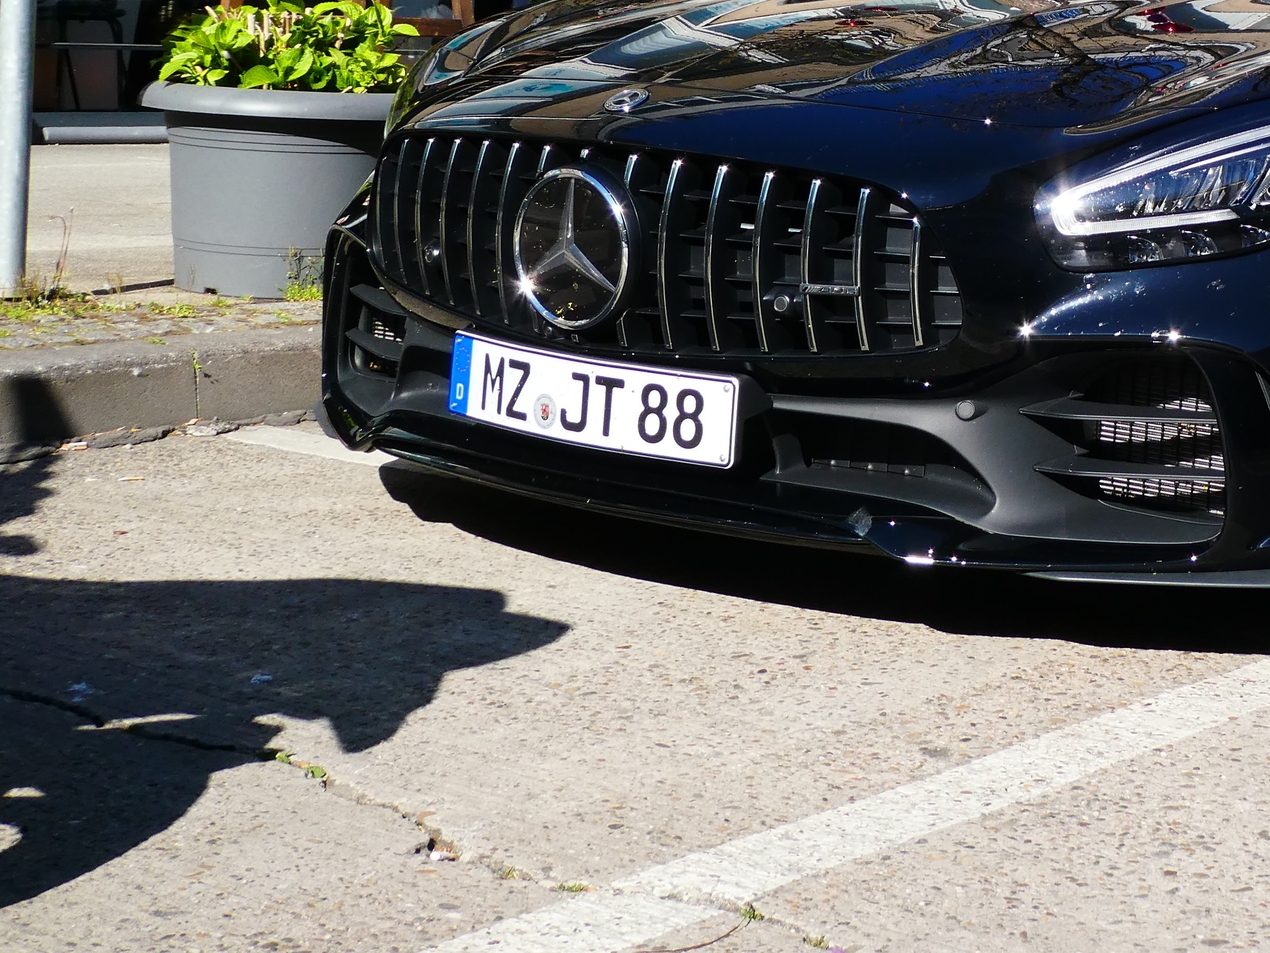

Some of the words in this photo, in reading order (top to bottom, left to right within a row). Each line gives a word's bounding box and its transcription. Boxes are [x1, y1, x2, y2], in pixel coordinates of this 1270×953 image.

[456, 382, 464, 400] D
[481, 352, 531, 422] MZ
[560, 371, 625, 437] JT
[637, 383, 705, 449] 88
